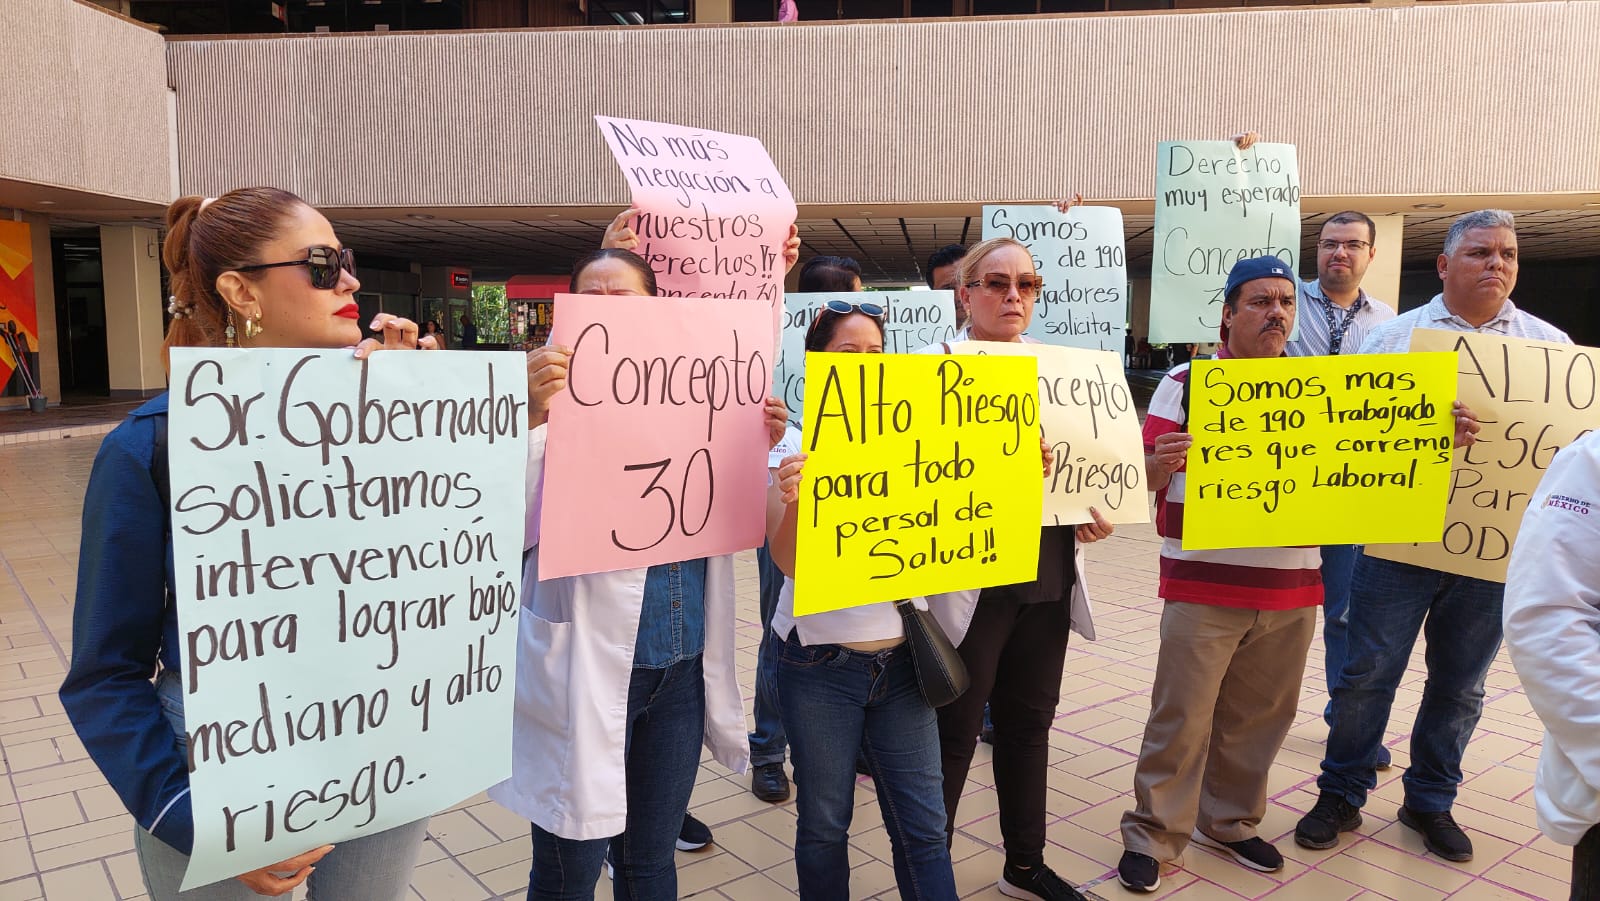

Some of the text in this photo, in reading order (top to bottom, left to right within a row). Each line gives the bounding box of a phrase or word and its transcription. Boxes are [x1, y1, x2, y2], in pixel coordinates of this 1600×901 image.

[608, 121, 658, 157] No
[1169, 145, 1281, 177] Derecho
[630, 167, 751, 209] negación
[1165, 174, 1300, 218] muy esperado
[635, 202, 764, 243] nuestros
[991, 208, 1088, 241] Somos
[1058, 245, 1087, 268] de
[1094, 245, 1124, 269] 190
[568, 322, 767, 442] Concepto
[1205, 367, 1416, 407] Somos mas
[1454, 335, 1596, 410] ALTO
[185, 355, 525, 465] Sr. Gobernador
[810, 362, 912, 451] Alto
[937, 359, 1036, 456] Riesgo
[1203, 411, 1248, 434] de
[1260, 409, 1306, 433] 190
[813, 439, 975, 528] para todo
[1051, 441, 1139, 510] Riesgo
[1201, 443, 1253, 465] res
[1267, 442, 1317, 470] que
[174, 456, 482, 535] solicitamos
[611, 448, 714, 551] 30
[1199, 478, 1297, 514] riesgo
[1449, 468, 1531, 514] Par
[836, 490, 993, 558] persal de
[194, 517, 498, 600] intervención
[187, 570, 517, 694] para lograr bajo,
[185, 634, 502, 773] mediano y alto
